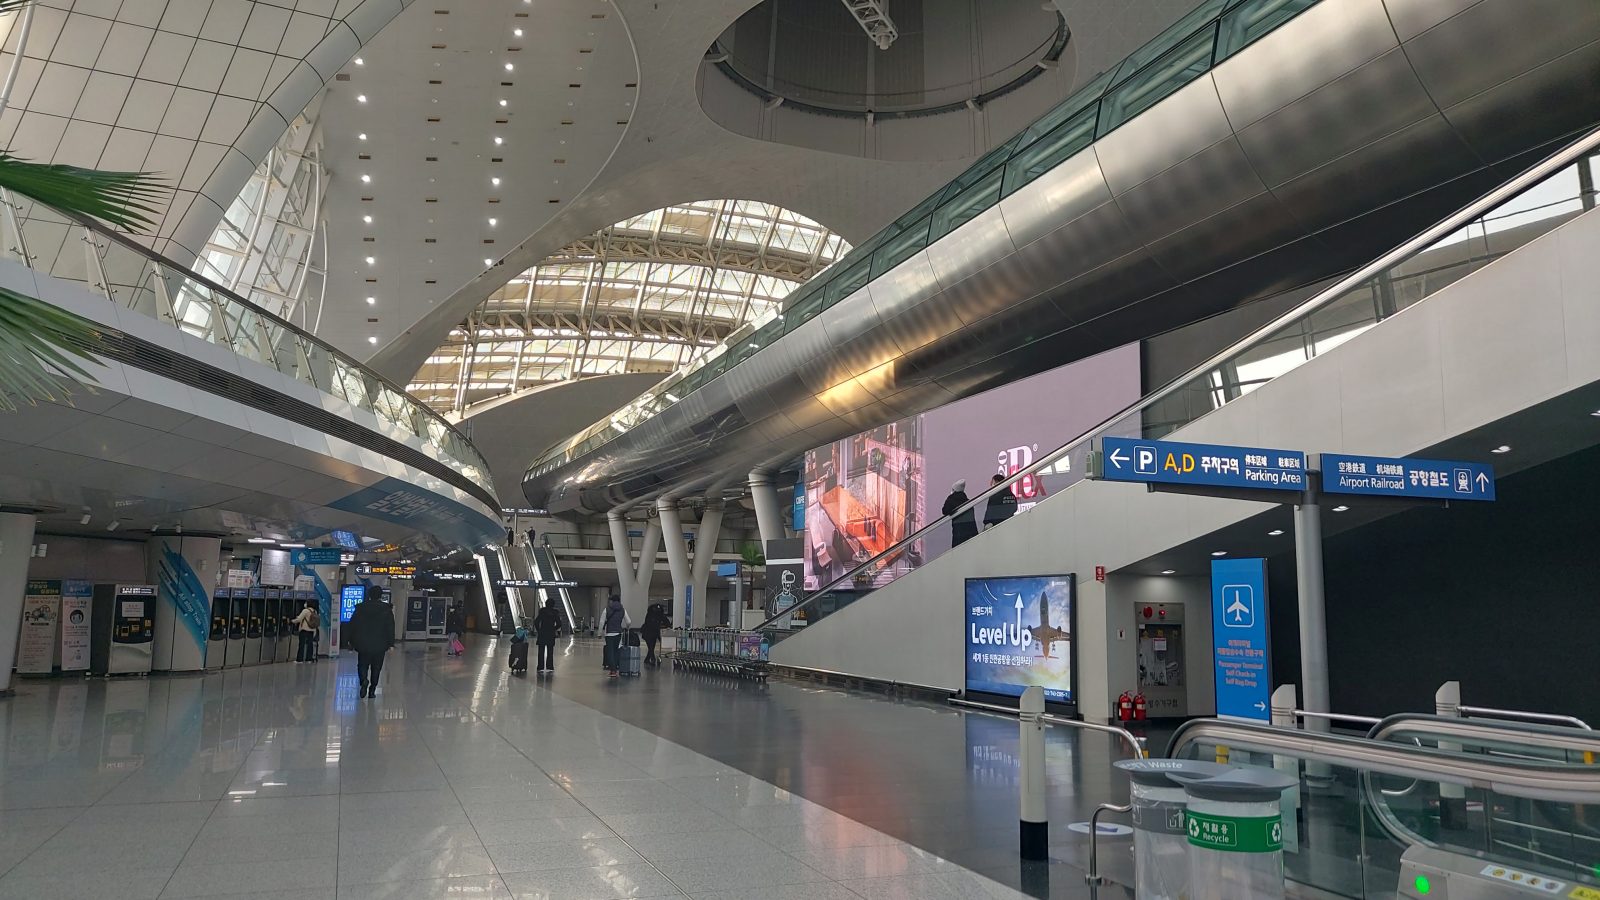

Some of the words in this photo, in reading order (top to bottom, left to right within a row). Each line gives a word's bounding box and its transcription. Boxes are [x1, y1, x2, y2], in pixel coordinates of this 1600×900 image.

[1140, 450, 1153, 470] P
[1164, 453, 1195, 474] A,D
[1201, 456, 1240, 475] 주차구역
[1245, 469, 1279, 485] Parking
[1281, 471, 1301, 484] Area
[1339, 475, 1370, 489] Airport
[1371, 477, 1405, 490] Railroad
[1409, 470, 1450, 487] 공항철도
[971, 622, 1007, 645] Level
[1010, 622, 1032, 651] Up
[982, 653, 989, 664] 1등
[989, 654, 1011, 665] 인천공항을
[1149, 761, 1183, 769] Waste
[1202, 822, 1229, 835] 재활용
[1202, 833, 1230, 844] Recycle
